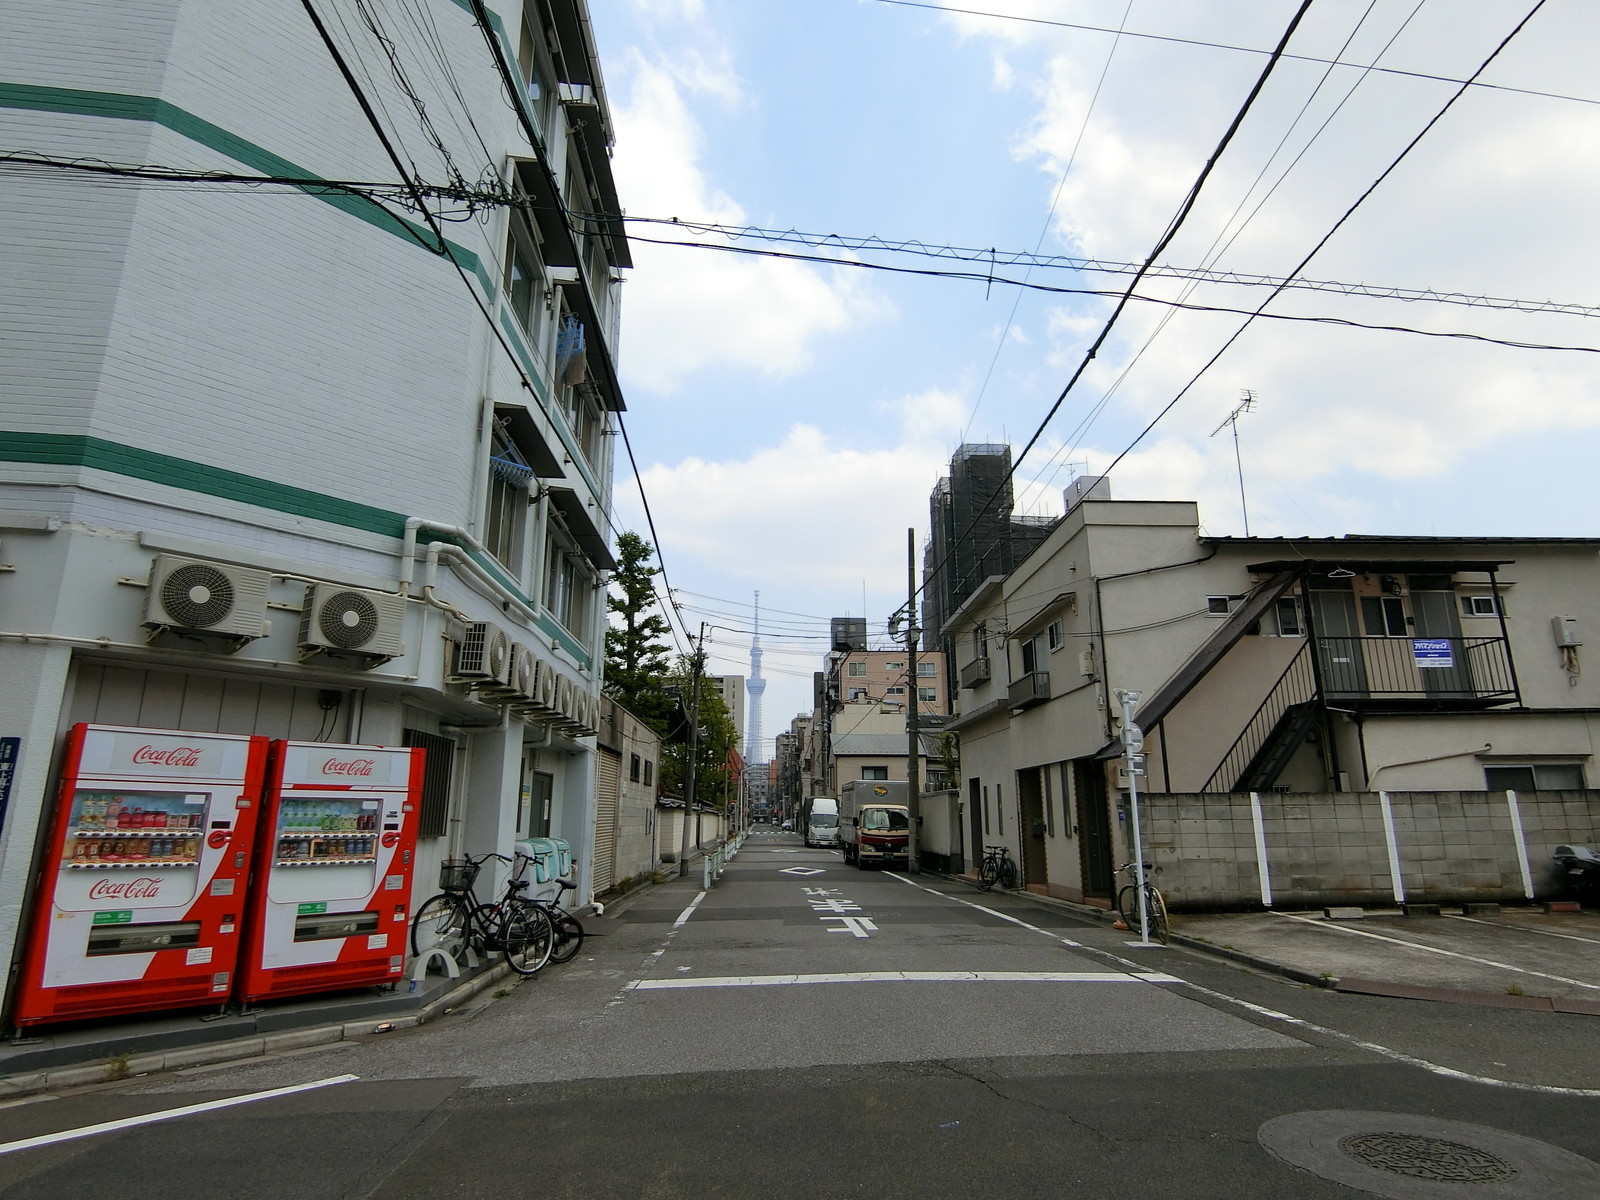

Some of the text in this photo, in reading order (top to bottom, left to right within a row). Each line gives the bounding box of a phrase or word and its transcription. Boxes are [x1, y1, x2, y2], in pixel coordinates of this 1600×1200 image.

[132, 744, 203, 767] Coca-Cola
[322, 757, 376, 776] Coca-Cola
[89, 877, 164, 900] Coca-Cola
[801, 887, 879, 938] 止まれ
